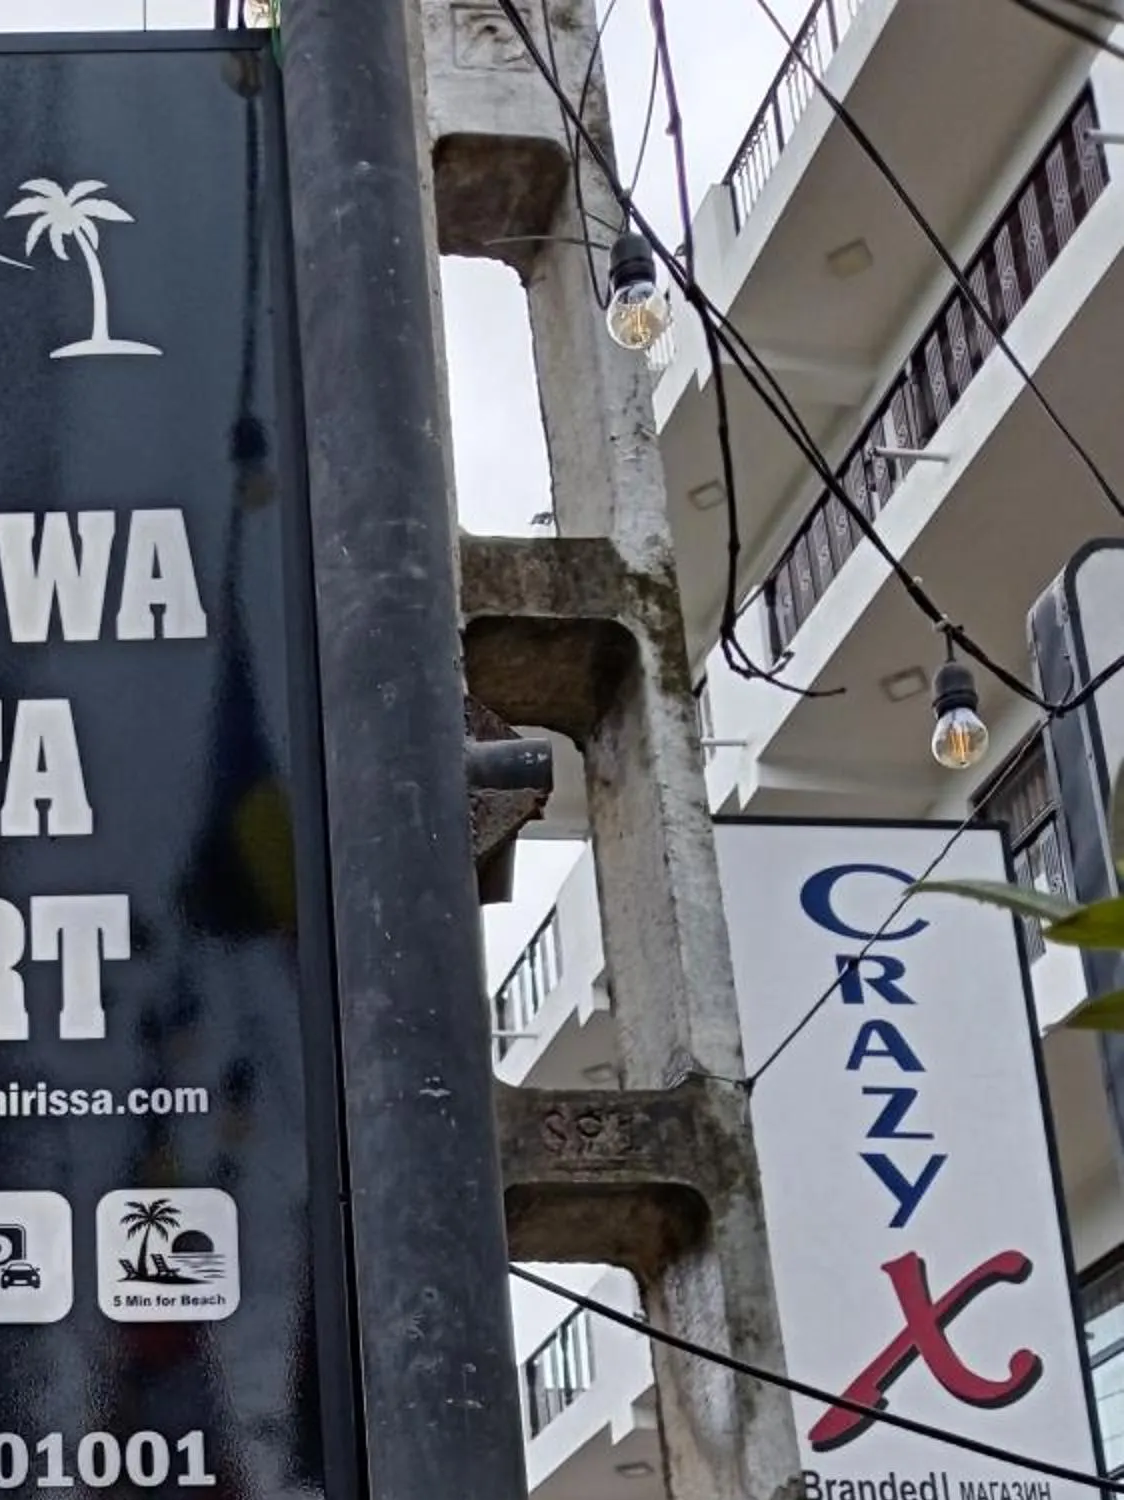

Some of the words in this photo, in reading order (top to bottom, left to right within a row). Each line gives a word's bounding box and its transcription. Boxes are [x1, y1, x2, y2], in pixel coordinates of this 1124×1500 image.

[113, 1295, 123, 1308] 5
[125, 1294, 152, 1307] Min
[155, 1294, 177, 1307] for
[180, 1293, 226, 1307] Beach
